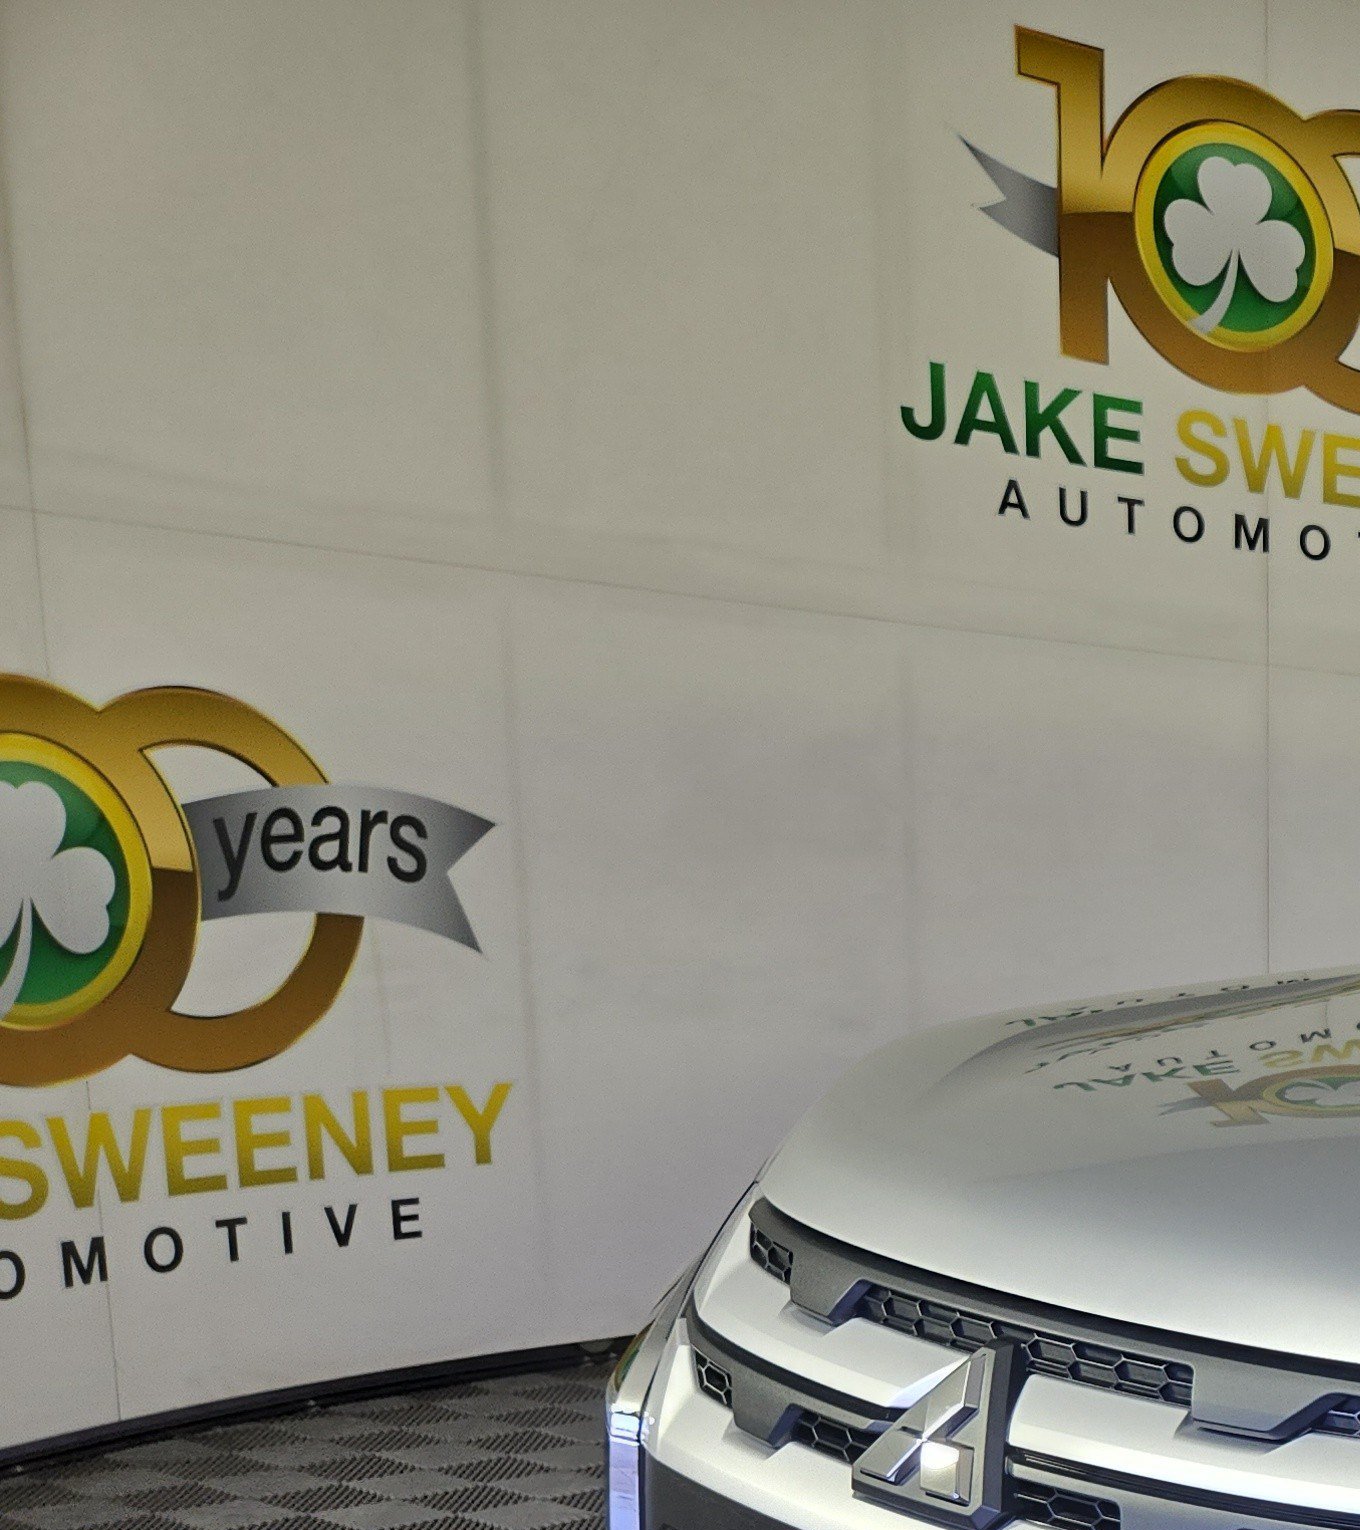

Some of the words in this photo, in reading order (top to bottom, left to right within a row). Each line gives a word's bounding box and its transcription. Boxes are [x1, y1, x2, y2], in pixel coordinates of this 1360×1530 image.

[900, 361, 1145, 476] JAKE
[212, 803, 429, 901] years
[0, 1082, 513, 1221] SWEENEY
